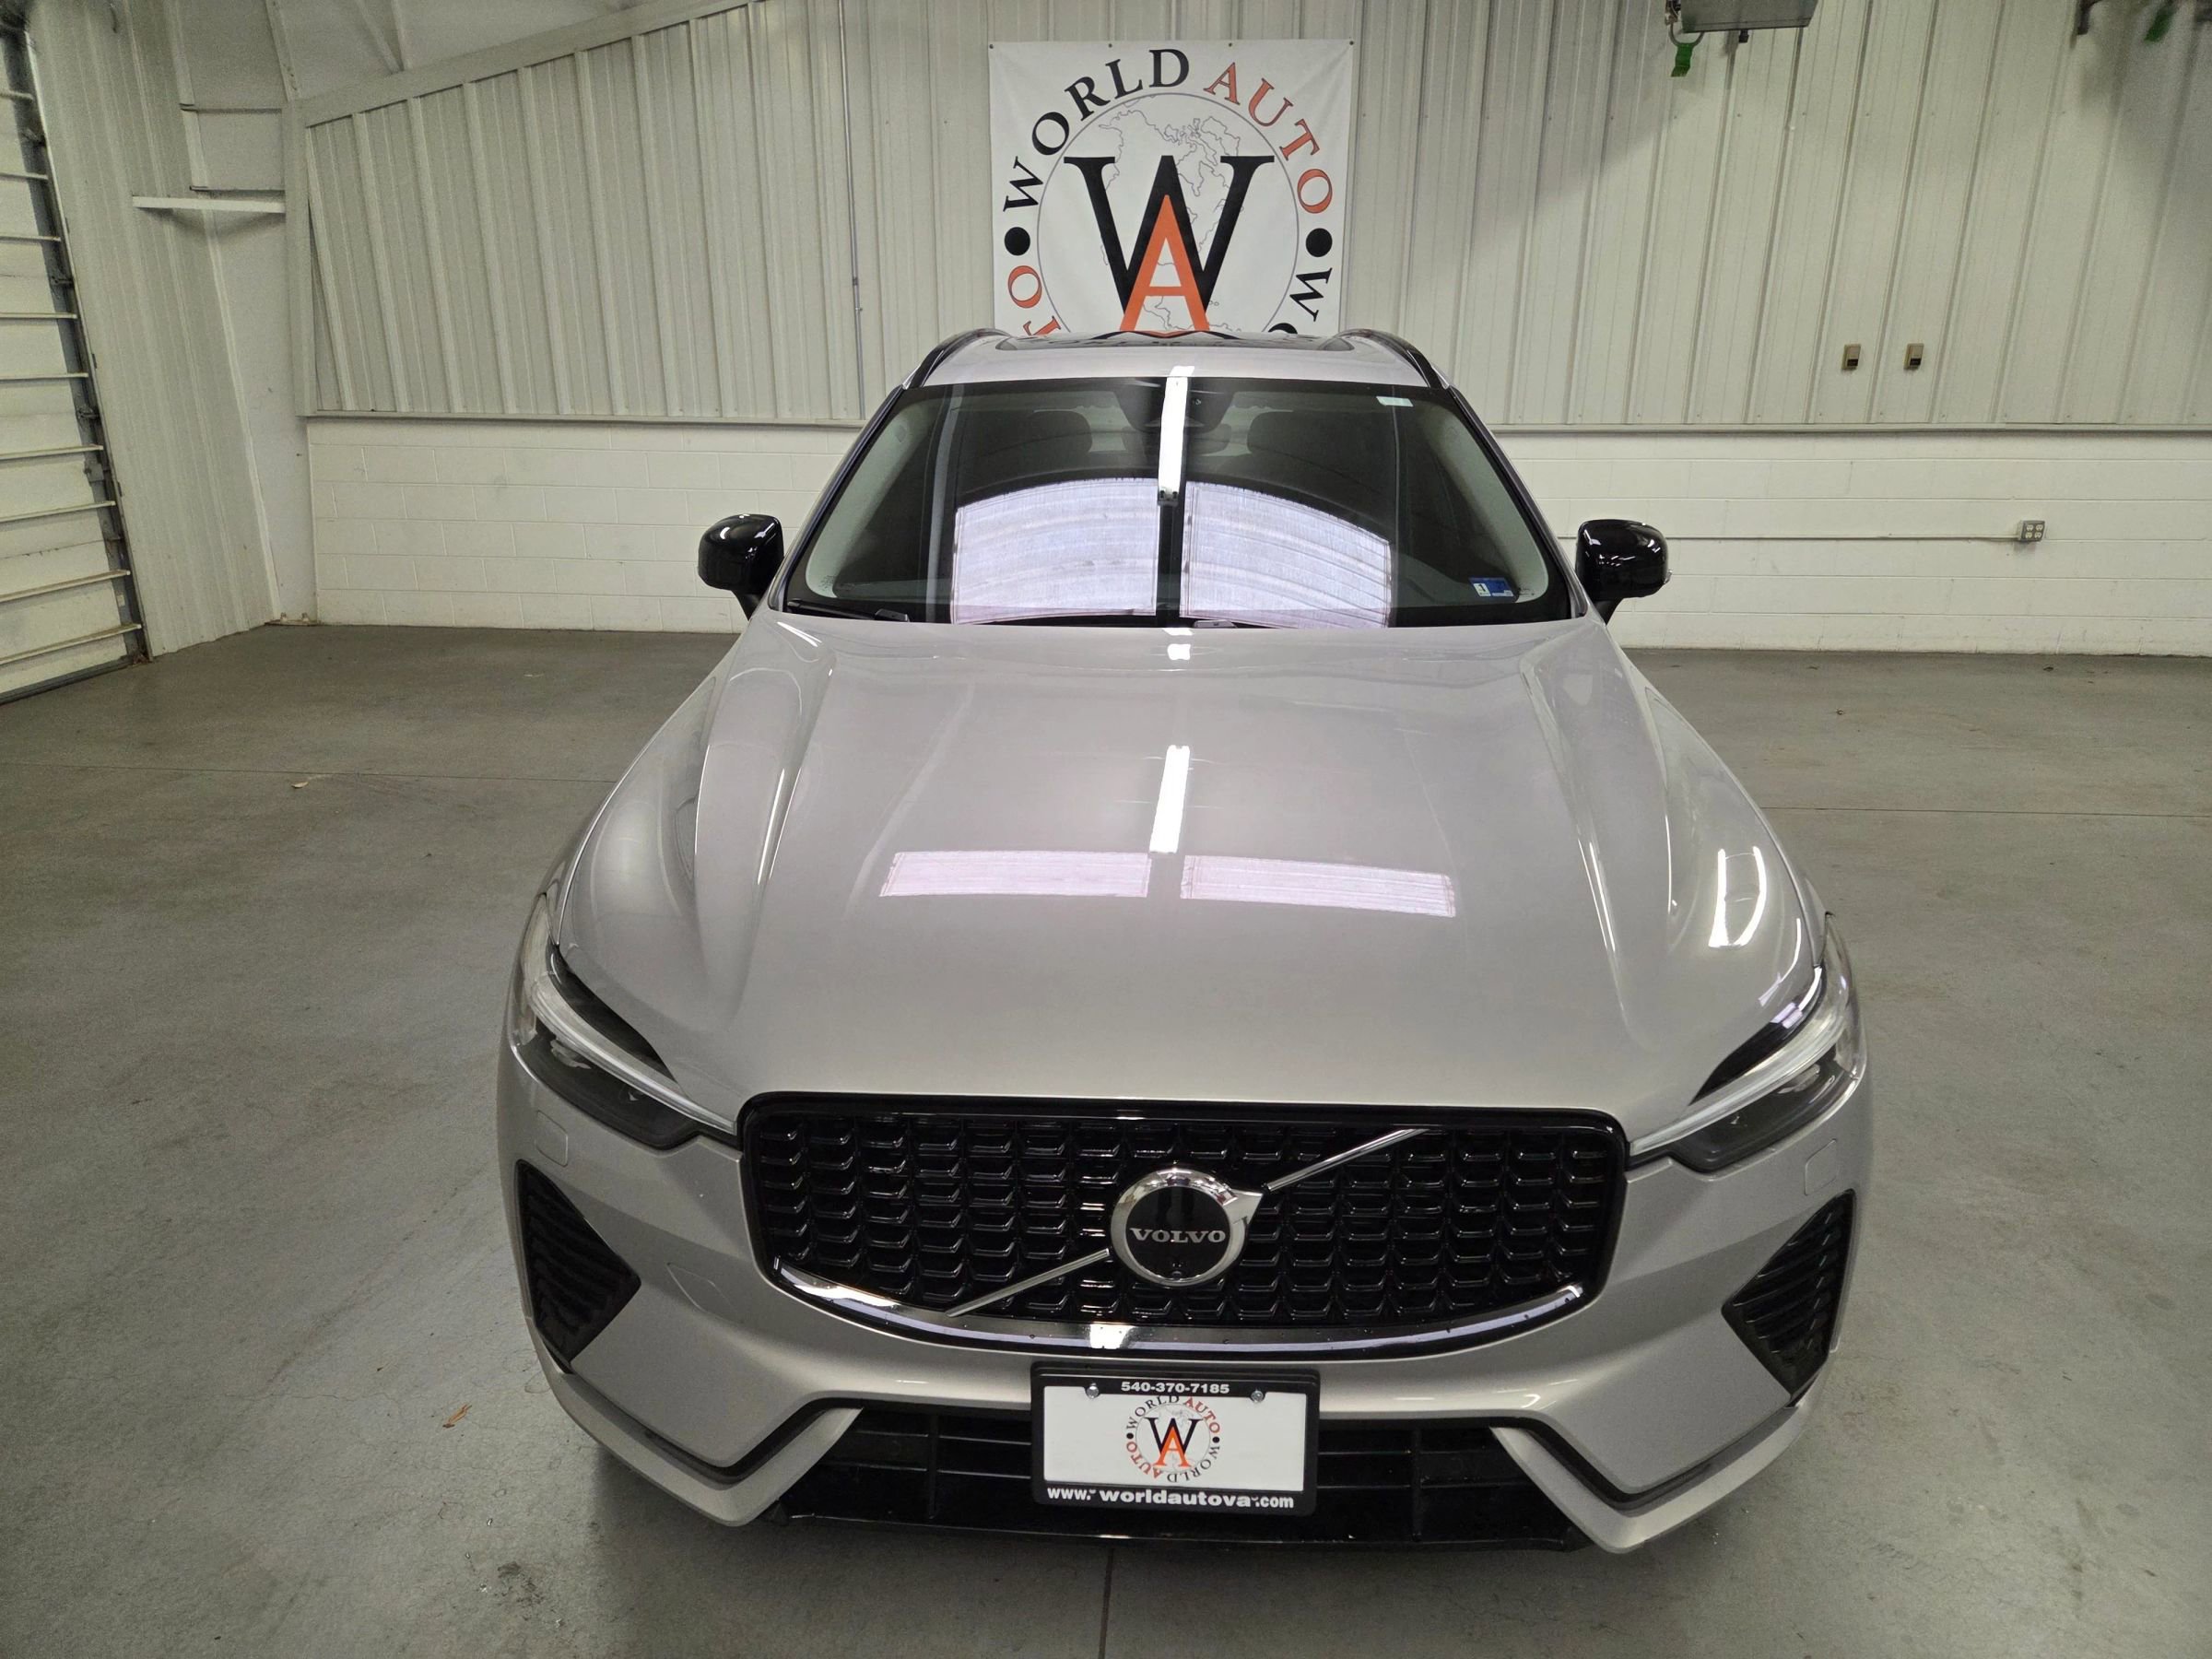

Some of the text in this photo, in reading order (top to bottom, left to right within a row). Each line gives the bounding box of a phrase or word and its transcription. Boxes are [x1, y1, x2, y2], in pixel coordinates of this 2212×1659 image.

[1003, 49, 1333, 214] WORLD AUTO
[1130, 1228, 1227, 1243] VOLVO
[1121, 1381, 1230, 1394] 540-370-7185
[1126, 1395, 1220, 1434] WORLD AUTO
[1126, 1441, 1220, 1483] WORLD AUTO
